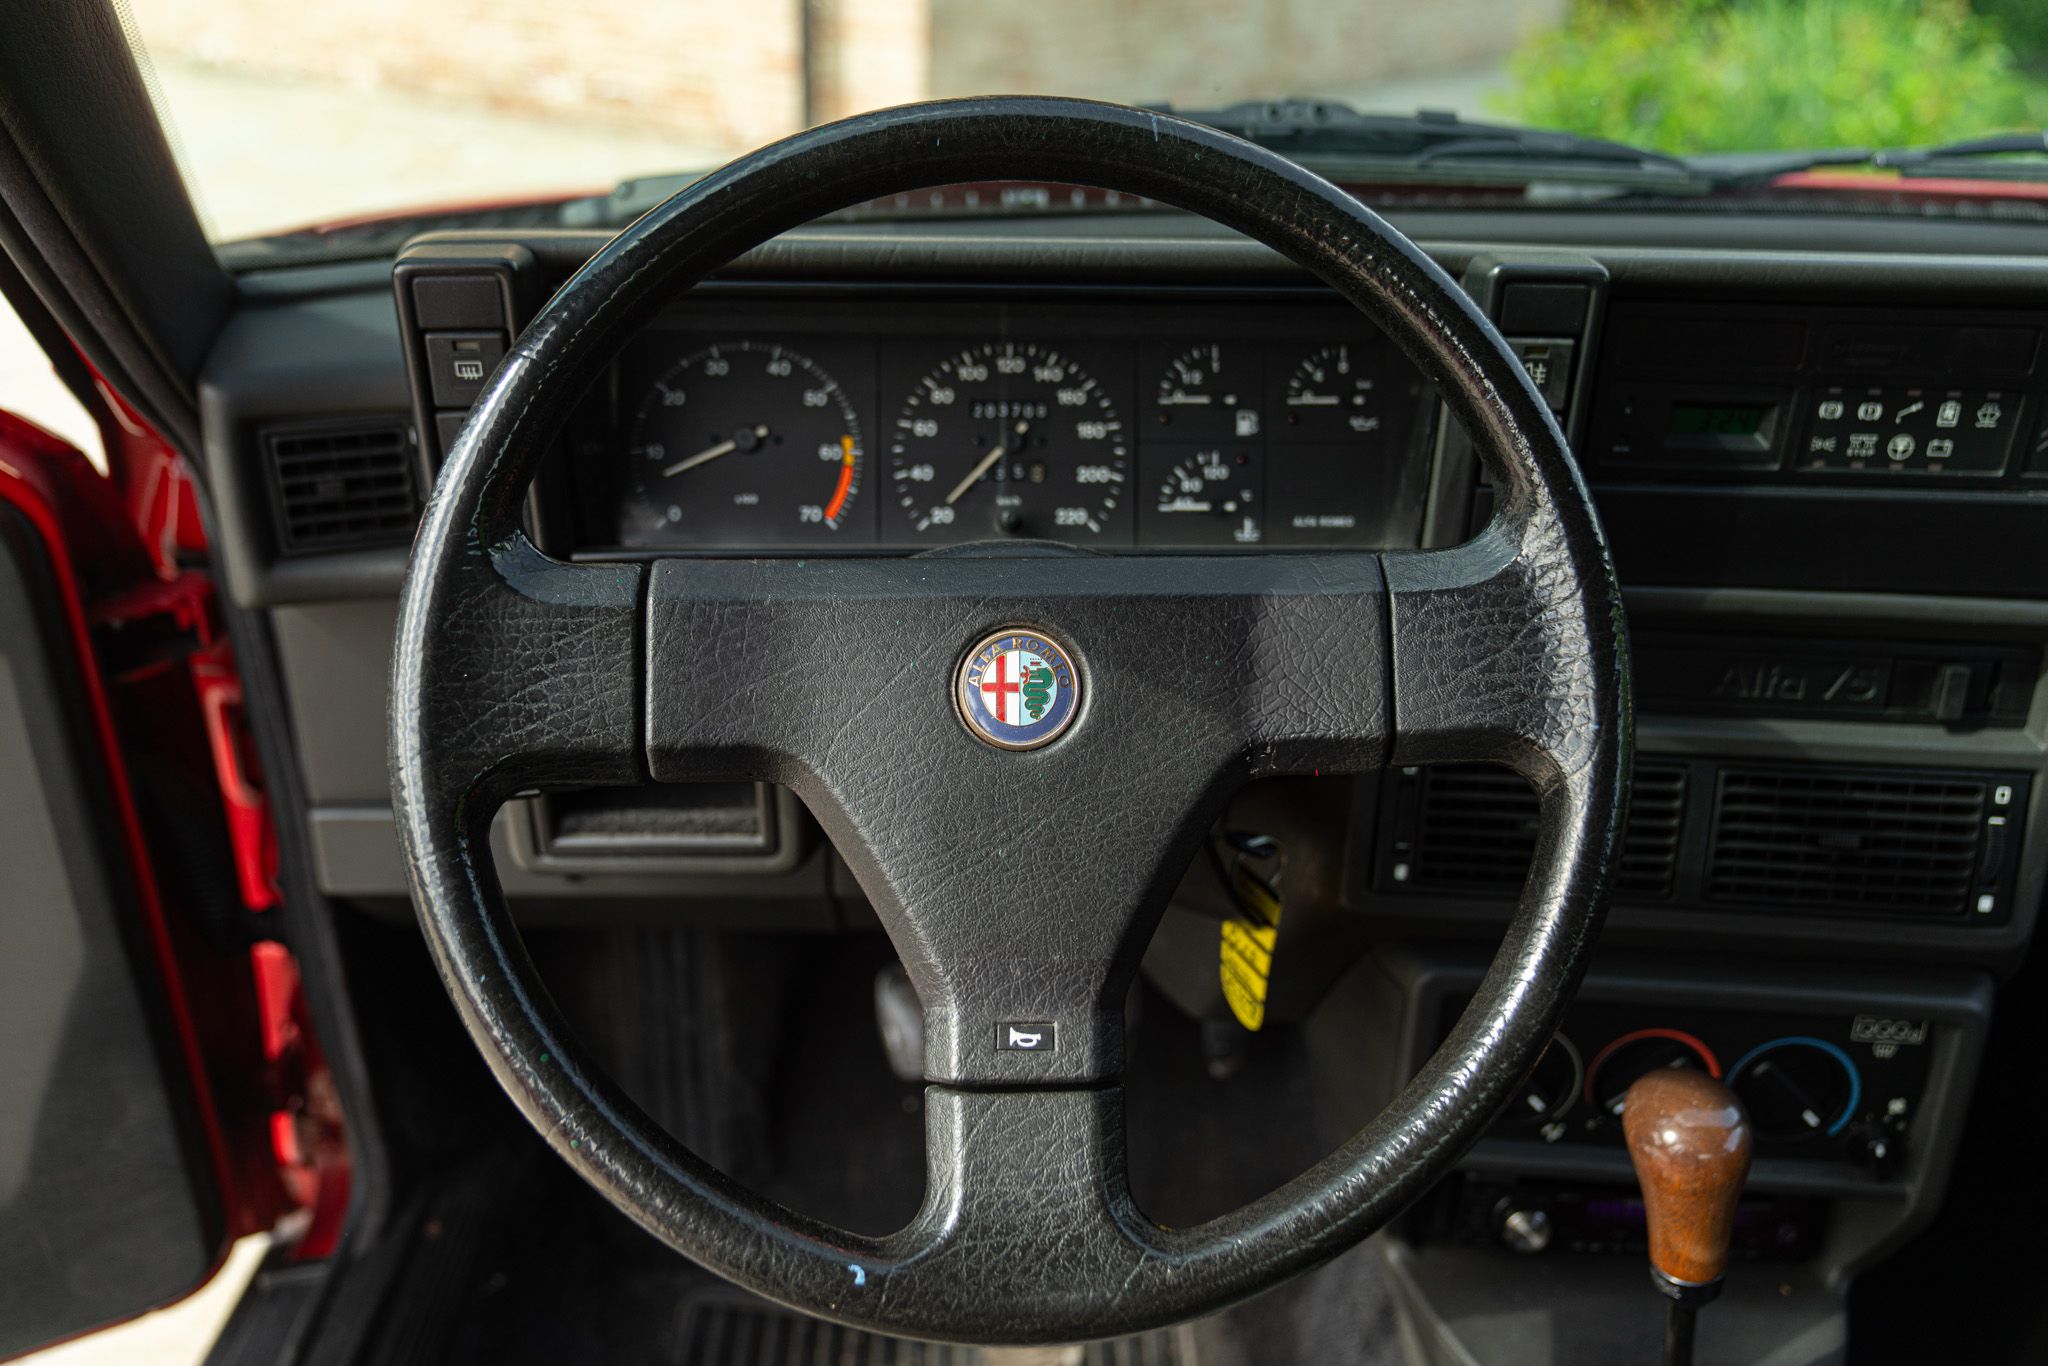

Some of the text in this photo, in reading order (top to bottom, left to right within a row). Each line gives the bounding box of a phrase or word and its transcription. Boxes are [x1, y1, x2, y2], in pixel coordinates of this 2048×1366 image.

[705, 359, 729, 376] 30
[766, 359, 791, 376] 40
[958, 365, 988, 381] 100
[1034, 365, 1064, 382] 140
[663, 389, 685, 406] 20
[803, 389, 828, 407] 50
[930, 387, 955, 404] 80
[1057, 388, 1087, 405] 160
[913, 419, 938, 437] 60
[1076, 421, 1107, 439] 180
[818, 444, 843, 461] 60
[910, 464, 934, 481] 40
[1076, 466, 1110, 483] 200
[667, 505, 682, 522] 0
[799, 505, 823, 522] 70
[930, 506, 954, 524] 20
[1055, 507, 1088, 525] 220
[968, 637, 1069, 689] ALFA ROMEO
